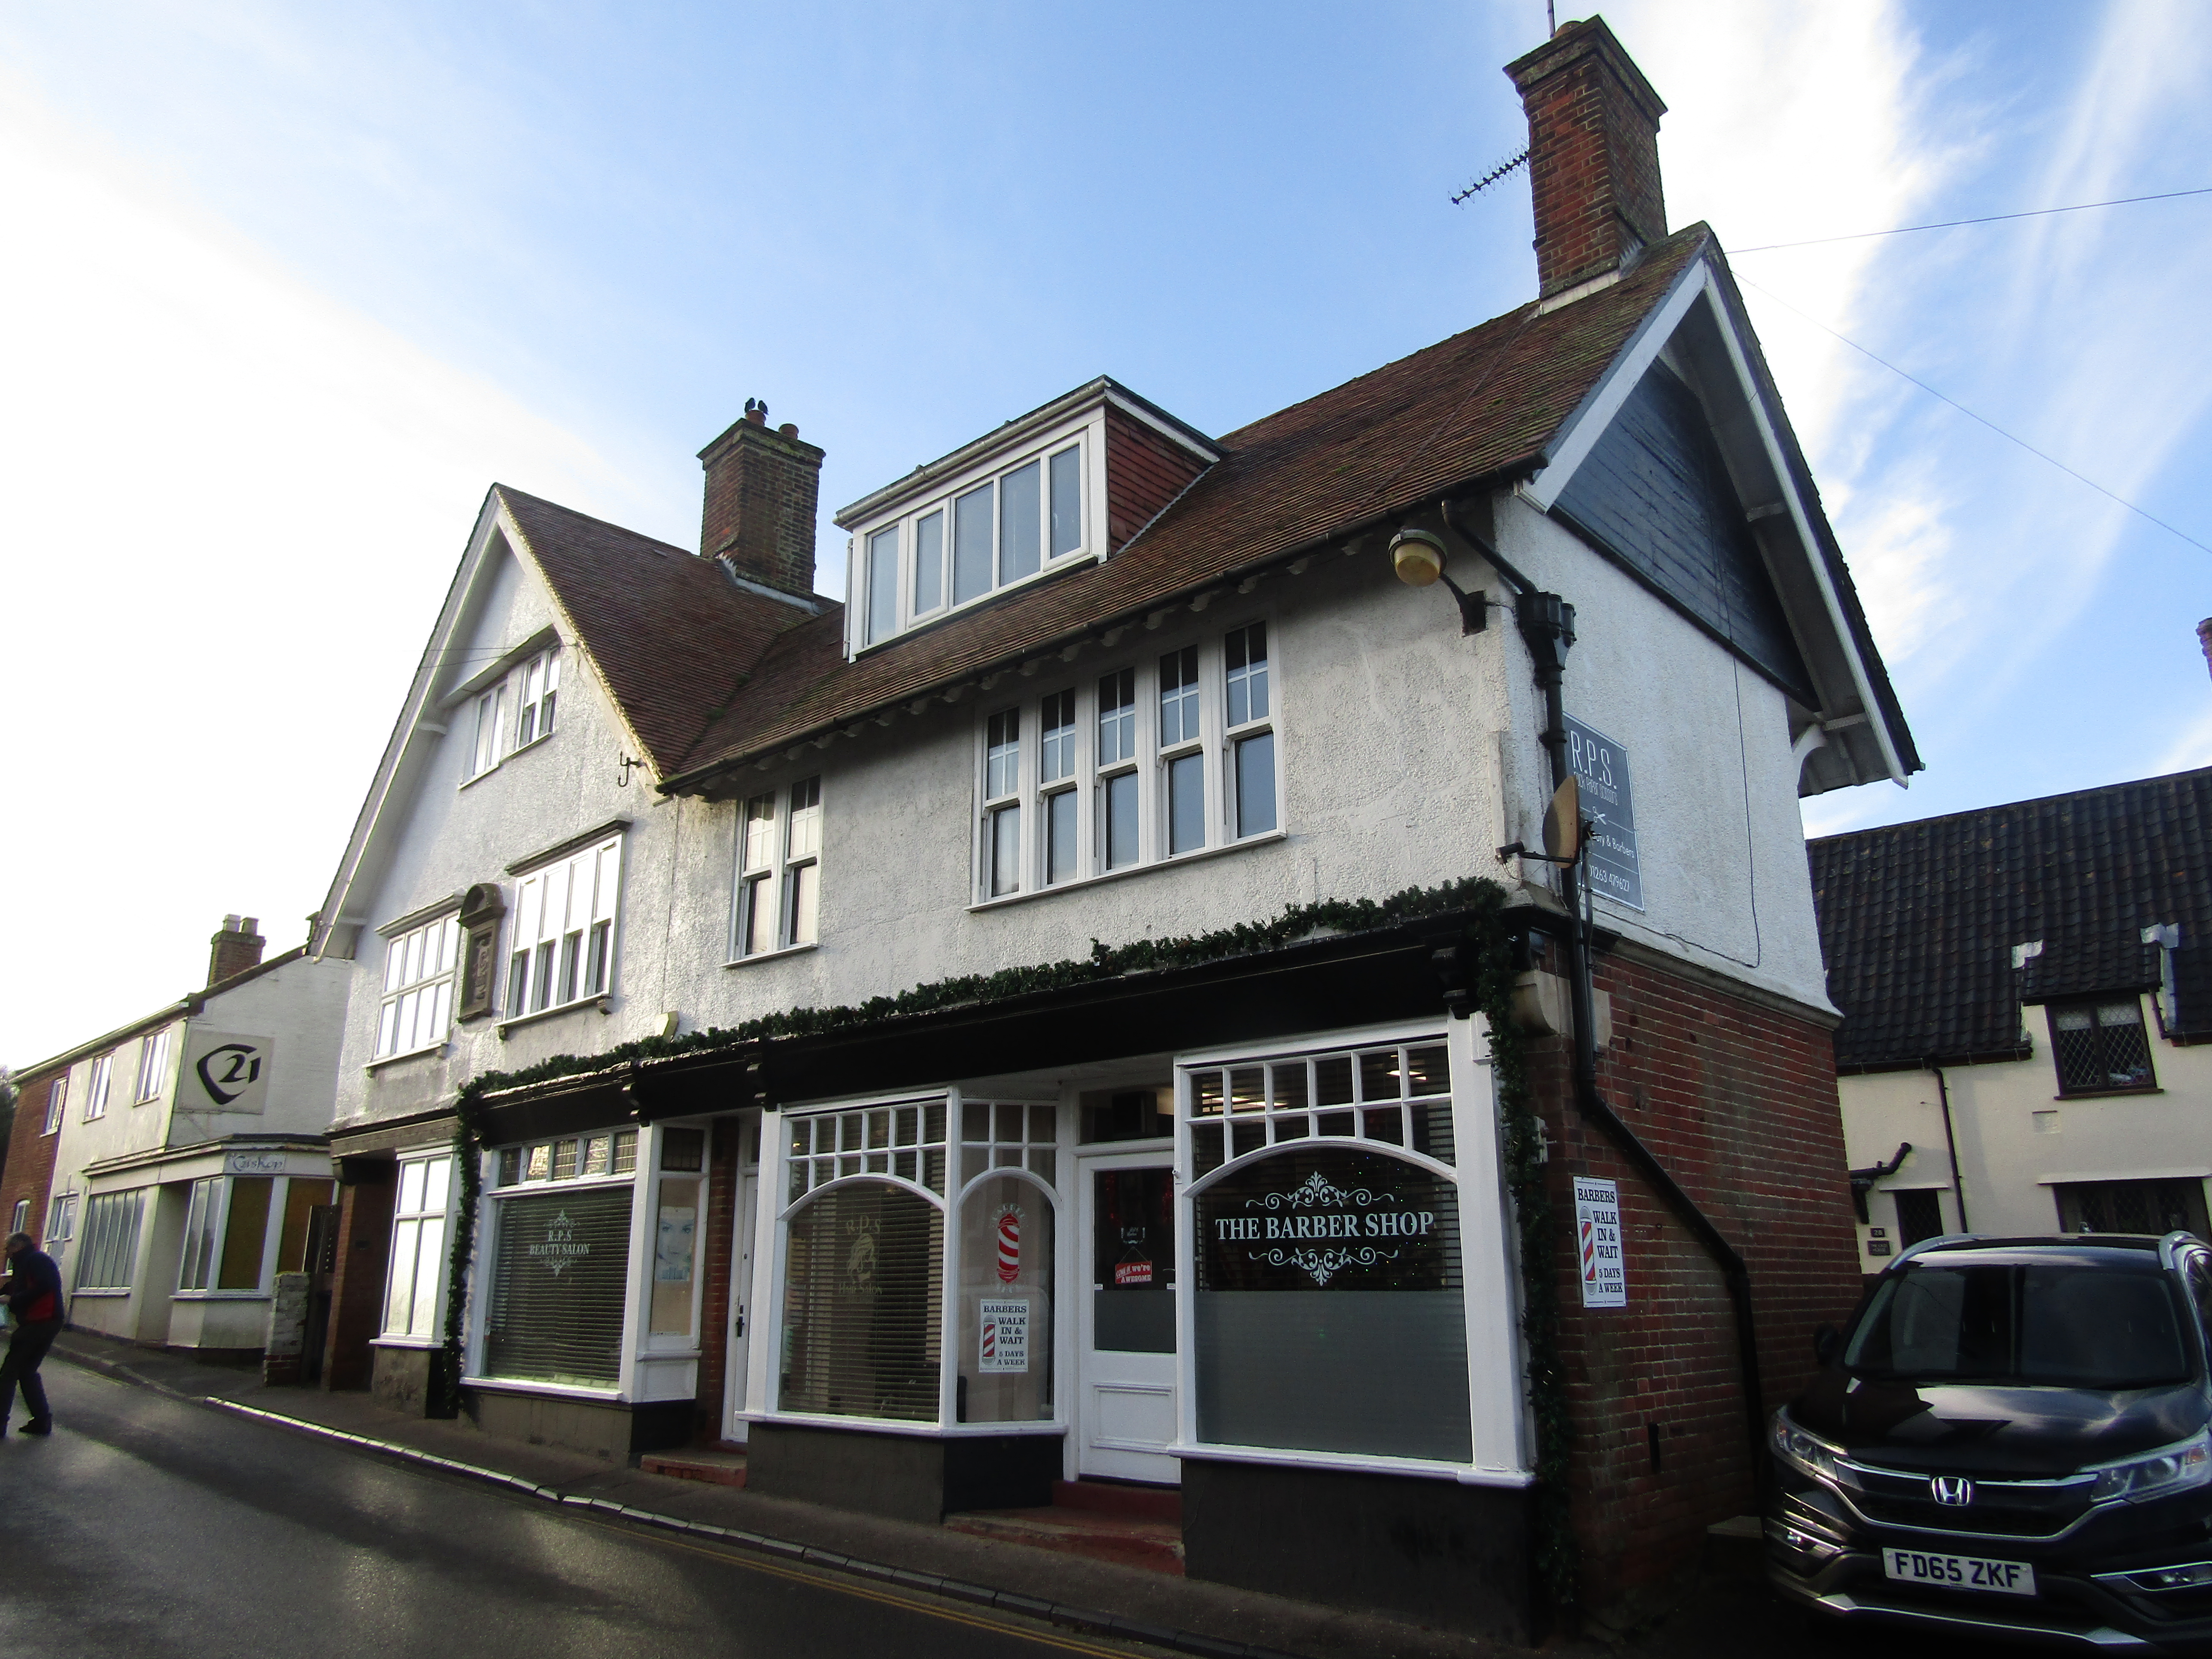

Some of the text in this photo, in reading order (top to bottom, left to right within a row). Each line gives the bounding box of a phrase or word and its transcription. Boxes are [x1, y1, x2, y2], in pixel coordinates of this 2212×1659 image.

[1606, 835, 1611, 848] &
[1612, 838, 1635, 858] Barbers
[1608, 873, 1630, 893] 479627
[1577, 1188, 1615, 1203] BARBERS
[1592, 1210, 1617, 1224] WALK
[1215, 1212, 1434, 1240] THE BARBER SHOP
[1597, 1228, 1616, 1242] IN &
[529, 1243, 590, 1255] BEAUTY SALON
[1597, 1245, 1618, 1259] WAIT
[1121, 1275, 1151, 1283] AWESOME
[1598, 1268, 1620, 1278] 5 DAYS
[1598, 1282, 1623, 1293] A WEEK
[999, 1317, 1026, 1325] WALK
[1894, 1552, 2021, 1588] FD65 ZKF
